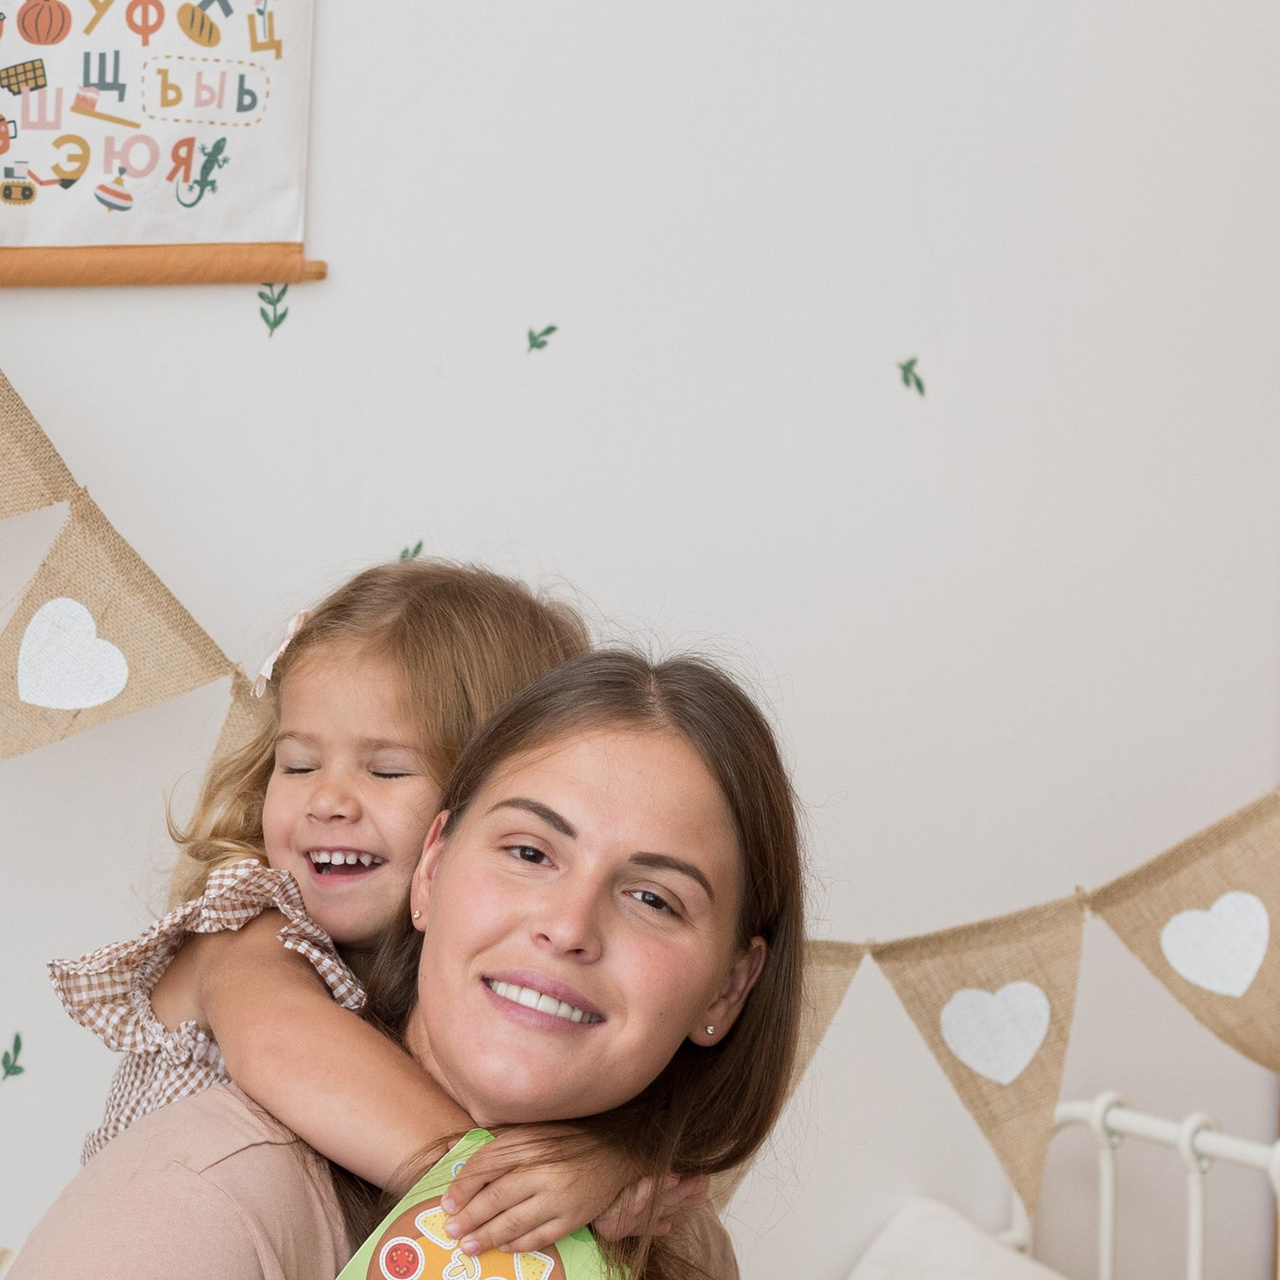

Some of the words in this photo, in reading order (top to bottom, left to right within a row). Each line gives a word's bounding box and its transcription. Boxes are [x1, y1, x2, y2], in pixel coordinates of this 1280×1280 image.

[246, 10, 283, 61] Ц
[19, 85, 64, 131] Ш
[83, 50, 127, 102] Щ
[156, 68, 183, 108] Ъ
[193, 70, 227, 110] Ы
[236, 73, 258, 113] Ь
[50, 133, 91, 182] Э
[103, 133, 160, 180] Ю
[166, 136, 196, 183] Я
